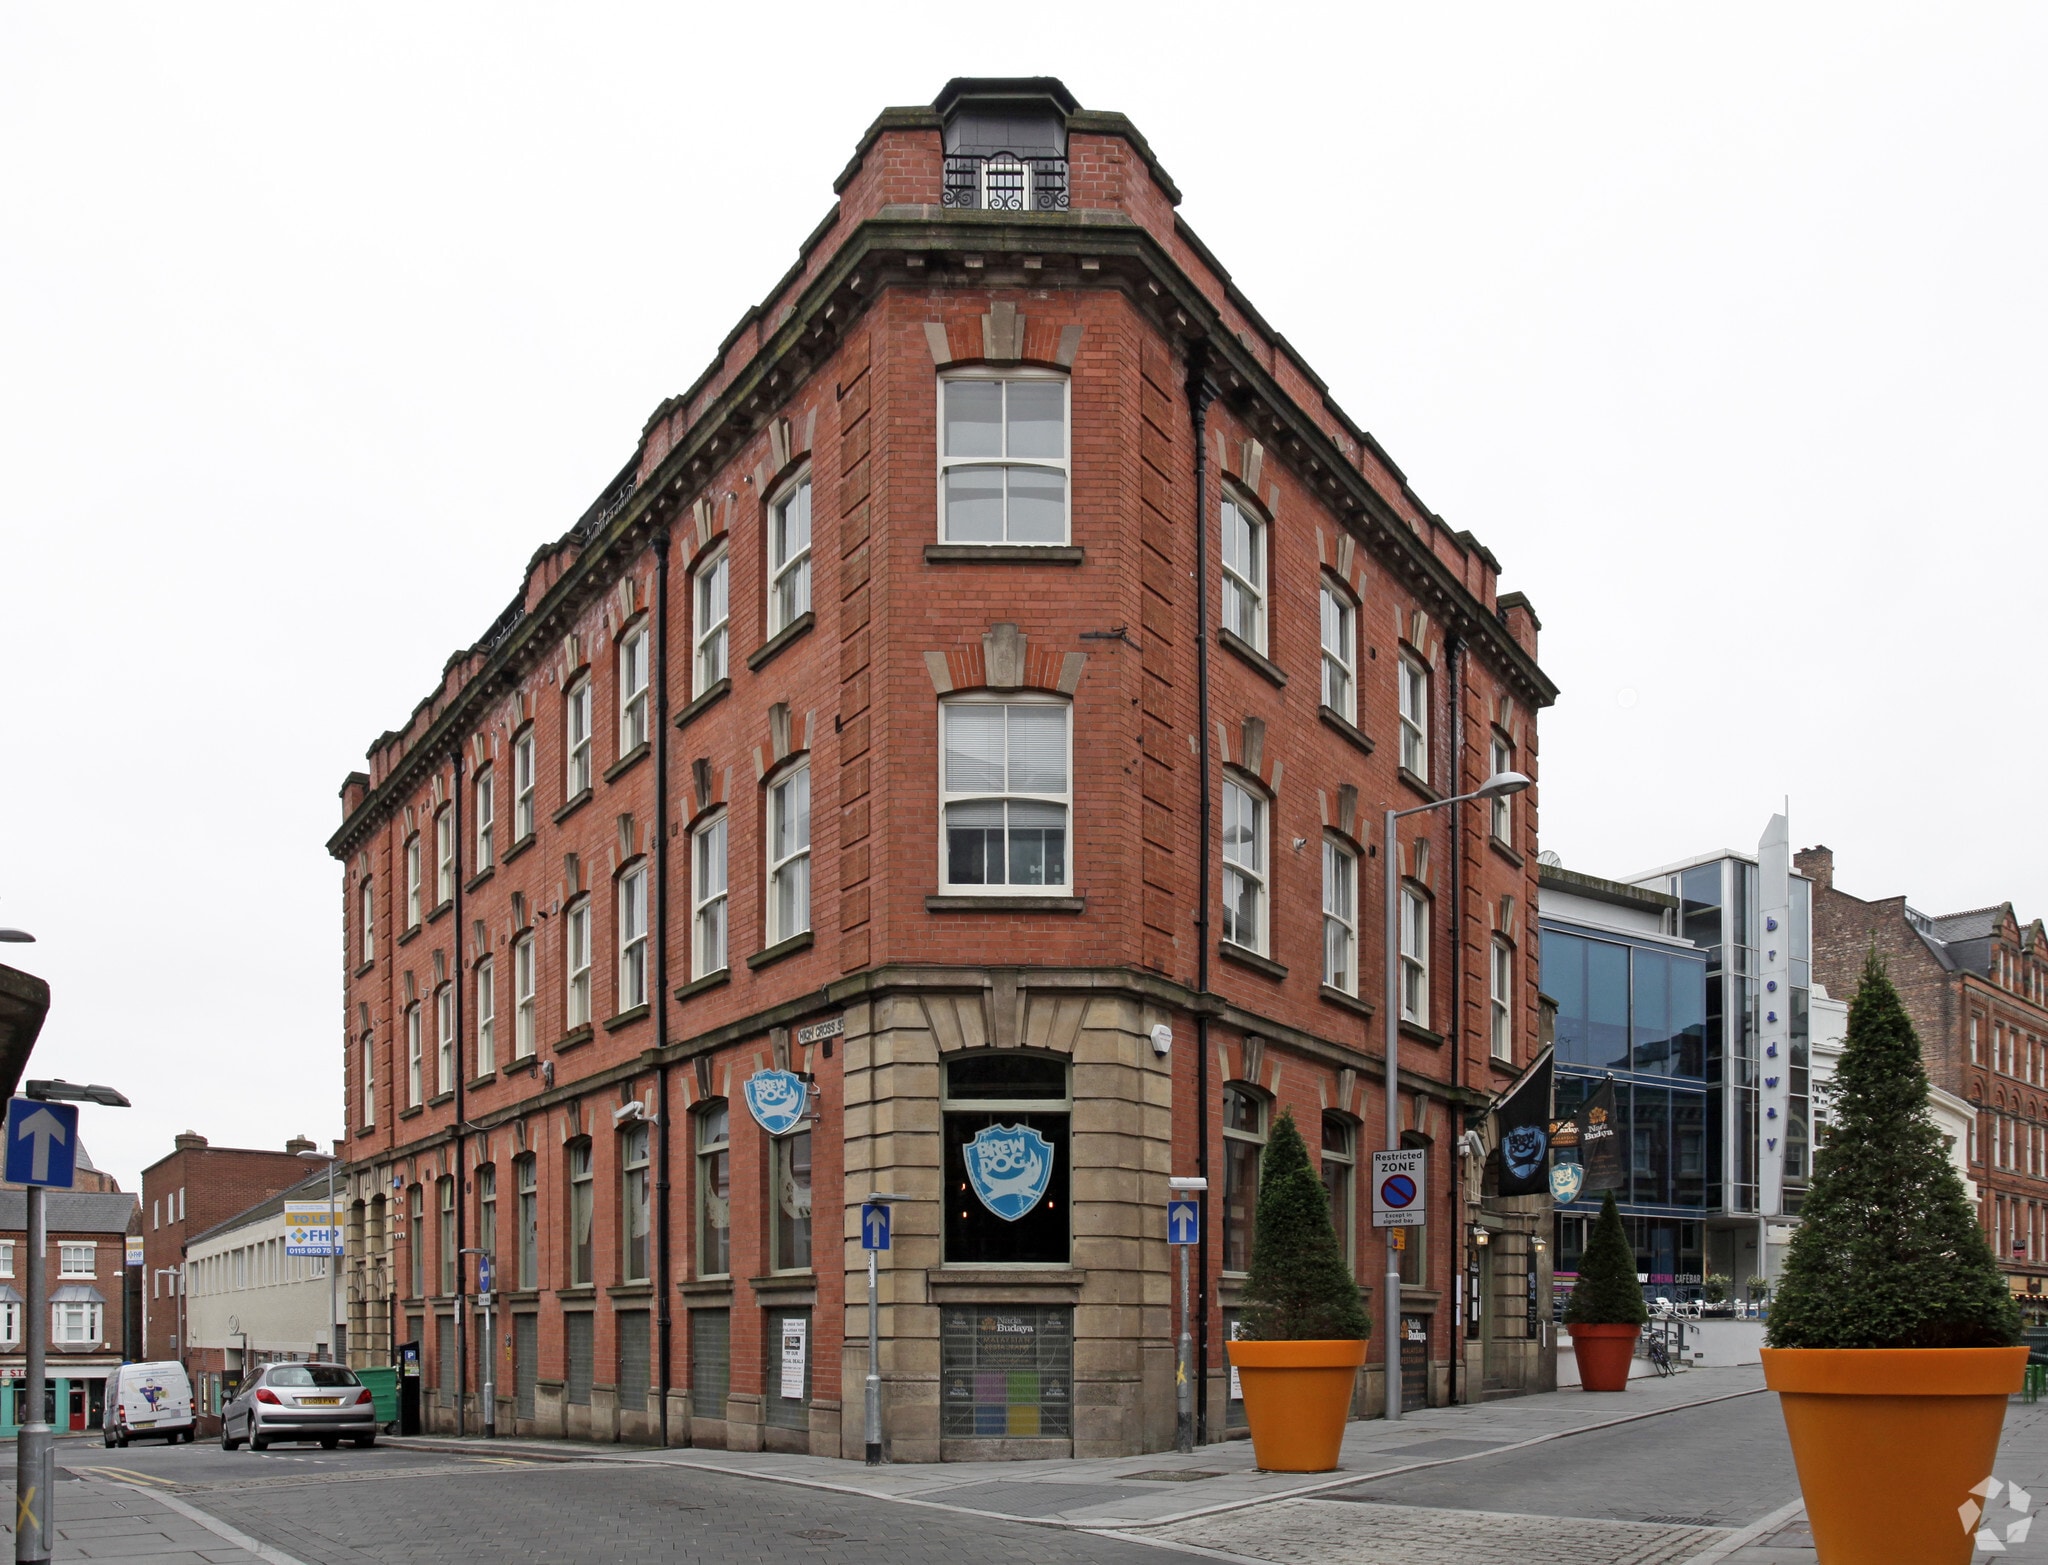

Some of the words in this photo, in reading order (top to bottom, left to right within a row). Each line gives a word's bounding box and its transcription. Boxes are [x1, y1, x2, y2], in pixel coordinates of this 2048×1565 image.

[799, 1026, 814, 1041] HIGH
[815, 1021, 835, 1037] CROSS
[1765, 916, 1780, 1151] broadway
[754, 1078, 787, 1092] BREW
[756, 1090, 789, 1101] DOG
[1509, 1131, 1535, 1144] BREW
[1584, 1129, 1614, 1141] Budaya
[977, 1137, 1026, 1158] BREW
[979, 1152, 1027, 1173] DOG
[1375, 1152, 1422, 1161] Restricted
[1381, 1162, 1415, 1172] ZONE
[293, 1215, 309, 1224] TO
[309, 1229, 339, 1241] FHP
[1650, 1274, 1673, 1284] CINEMA
[1674, 1272, 1701, 1283] CAFÉBAR
[996, 1316, 1022, 1325] Nada
[996, 1324, 1034, 1334] Budaya
